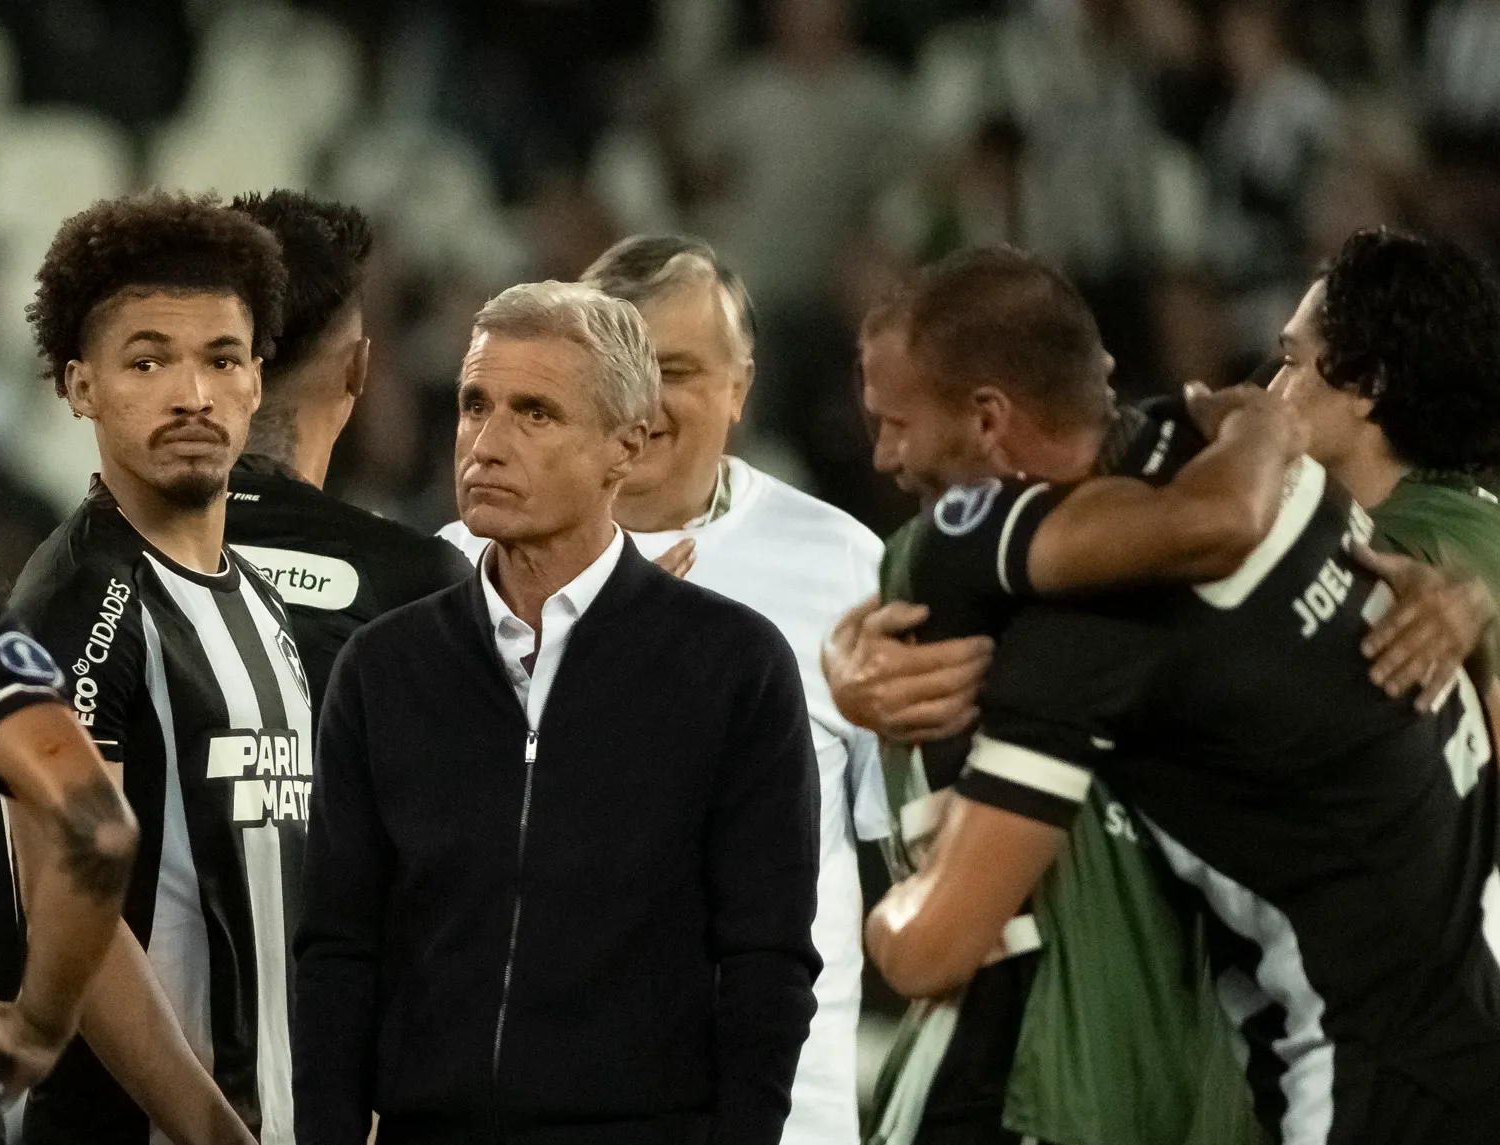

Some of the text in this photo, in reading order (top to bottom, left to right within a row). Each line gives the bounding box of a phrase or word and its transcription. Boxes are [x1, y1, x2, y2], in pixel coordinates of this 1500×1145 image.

[234, 493, 261, 502] FIRE
[85, 577, 131, 664] CIDADES
[1292, 557, 1354, 639] JOEL
[74, 677, 98, 726] ECO
[207, 736, 297, 778] PARI
